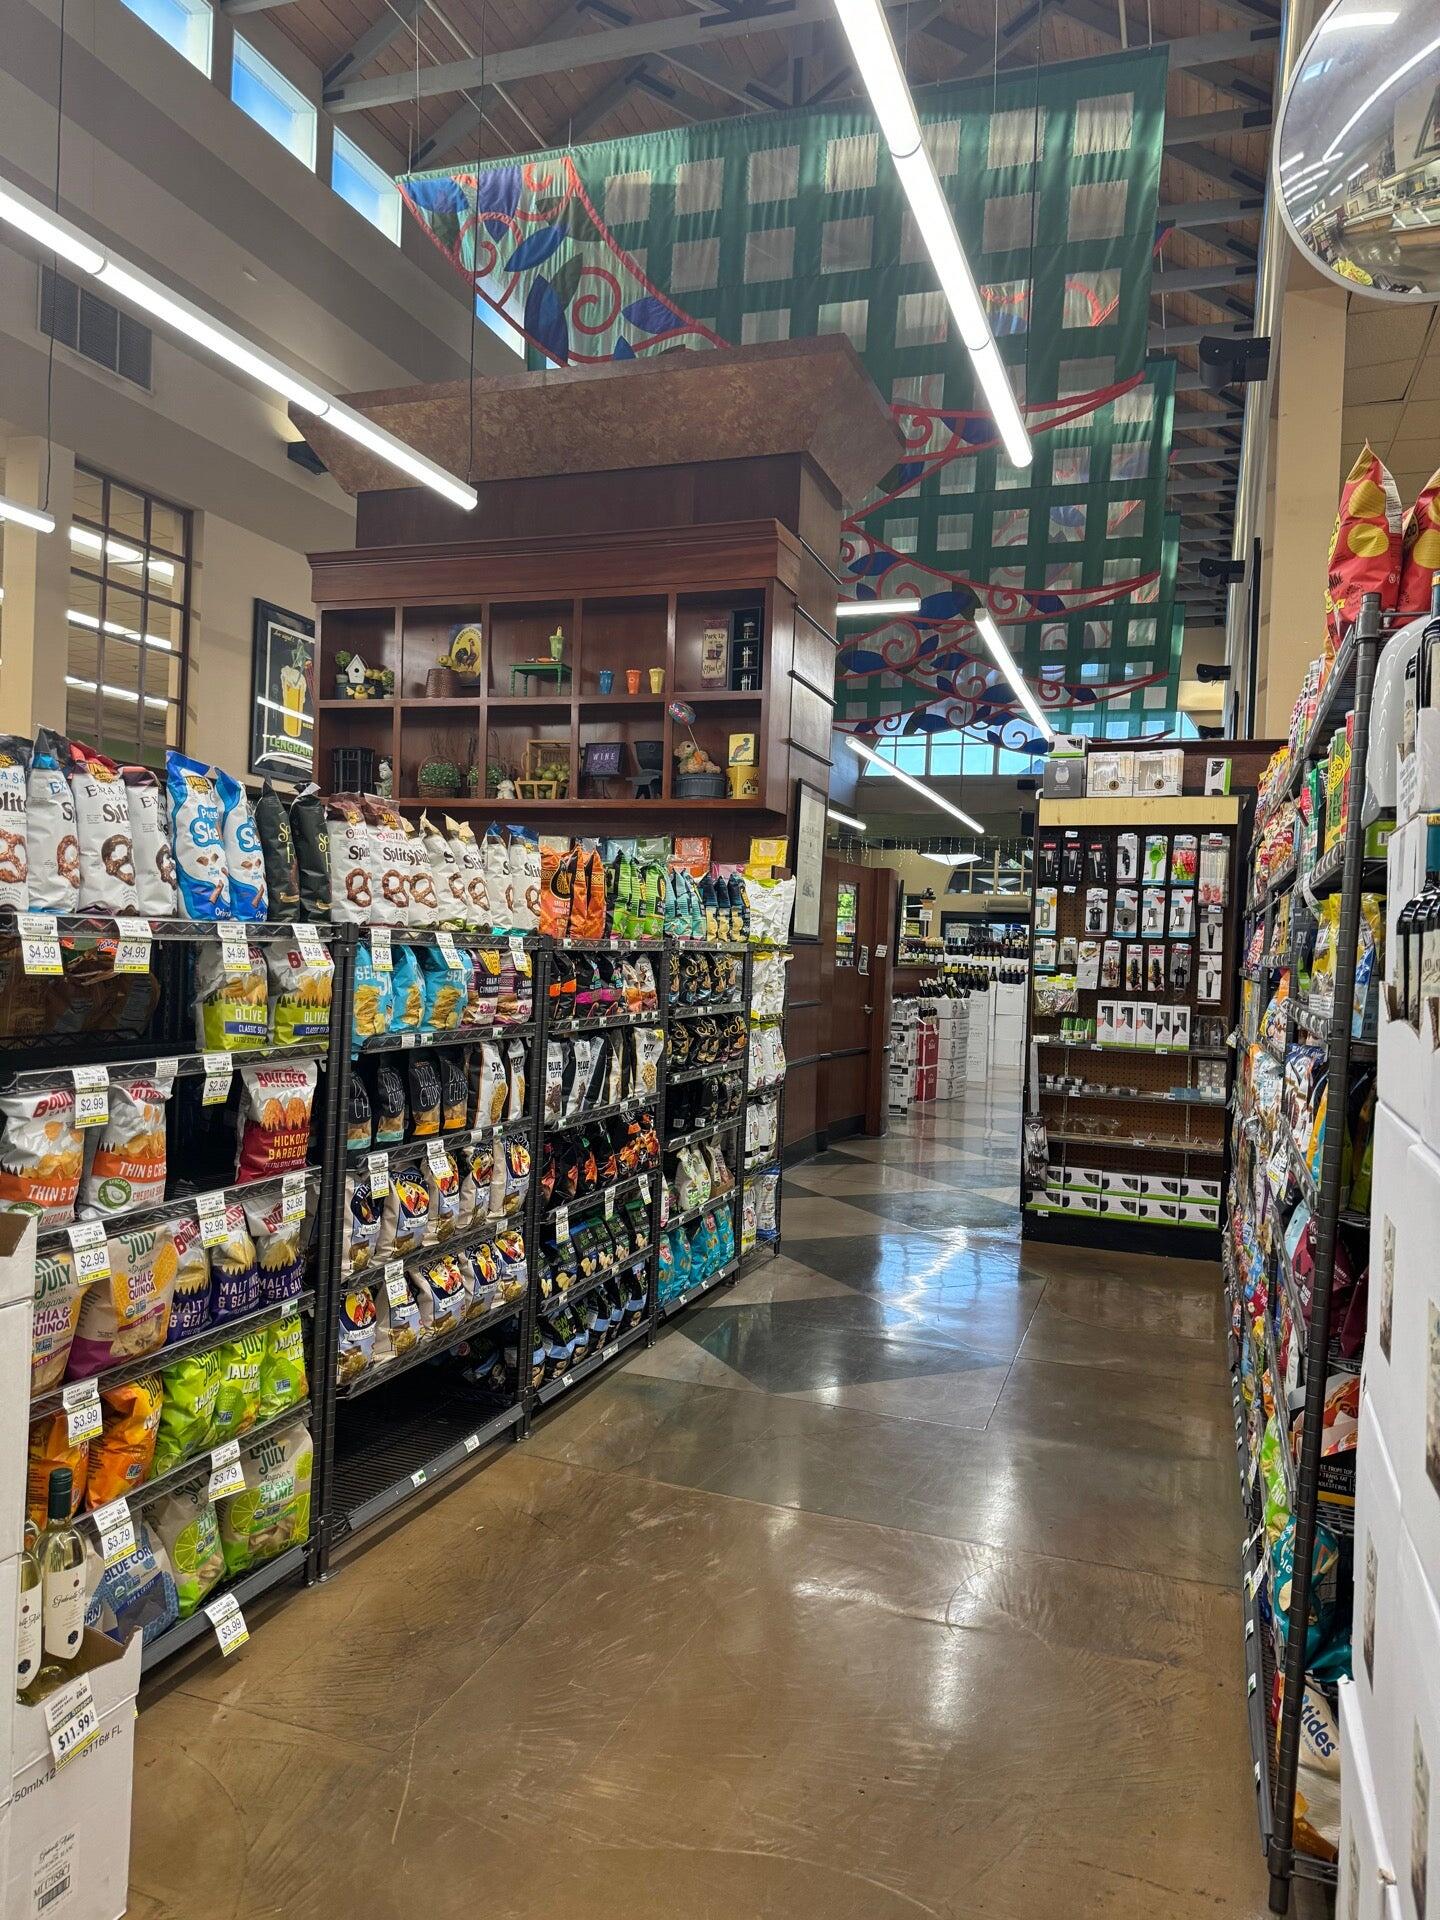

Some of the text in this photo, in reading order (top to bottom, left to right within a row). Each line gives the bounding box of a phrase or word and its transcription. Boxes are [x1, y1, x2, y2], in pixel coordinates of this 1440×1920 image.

[593, 752, 615, 761] WINE
[28, 945, 57, 959] $4.99
[121, 945, 148, 959] $4.99
[226, 947, 247, 960] $4.99
[303, 949, 320, 959] $4.99
[235, 1008, 263, 1021] OLIVE
[208, 1079, 229, 1092] $2.99
[256, 1070, 308, 1087] BOULDER
[80, 1098, 104, 1112] $2.99
[273, 1132, 310, 1147] HICKORY
[118, 1161, 145, 1178] THIN
[27, 1184, 67, 1201] THIN &
[286, 1196, 303, 1211] $2.99
[204, 1219, 225, 1235] $2.99
[128, 1231, 156, 1264] JULY
[80, 1251, 105, 1269] $2.99
[35, 1263, 71, 1300] JULY
[128, 1272, 148, 1289] CHIA
[220, 1280, 248, 1296] MALT
[128, 1281, 155, 1300] QUINOA
[62, 1305, 71, 1319] &
[240, 1334, 265, 1360] JULY
[73, 1409, 99, 1430] $3.99
[259, 1445, 286, 1475] JULY
[213, 1466, 238, 1486] $3.79
[107, 1528, 131, 1551] $3.79
[104, 1560, 131, 1582] BLUE
[221, 1617, 242, 1639] $3.99
[58, 1714, 90, 1750] $11.99
[111, 1724, 123, 1738] FL
